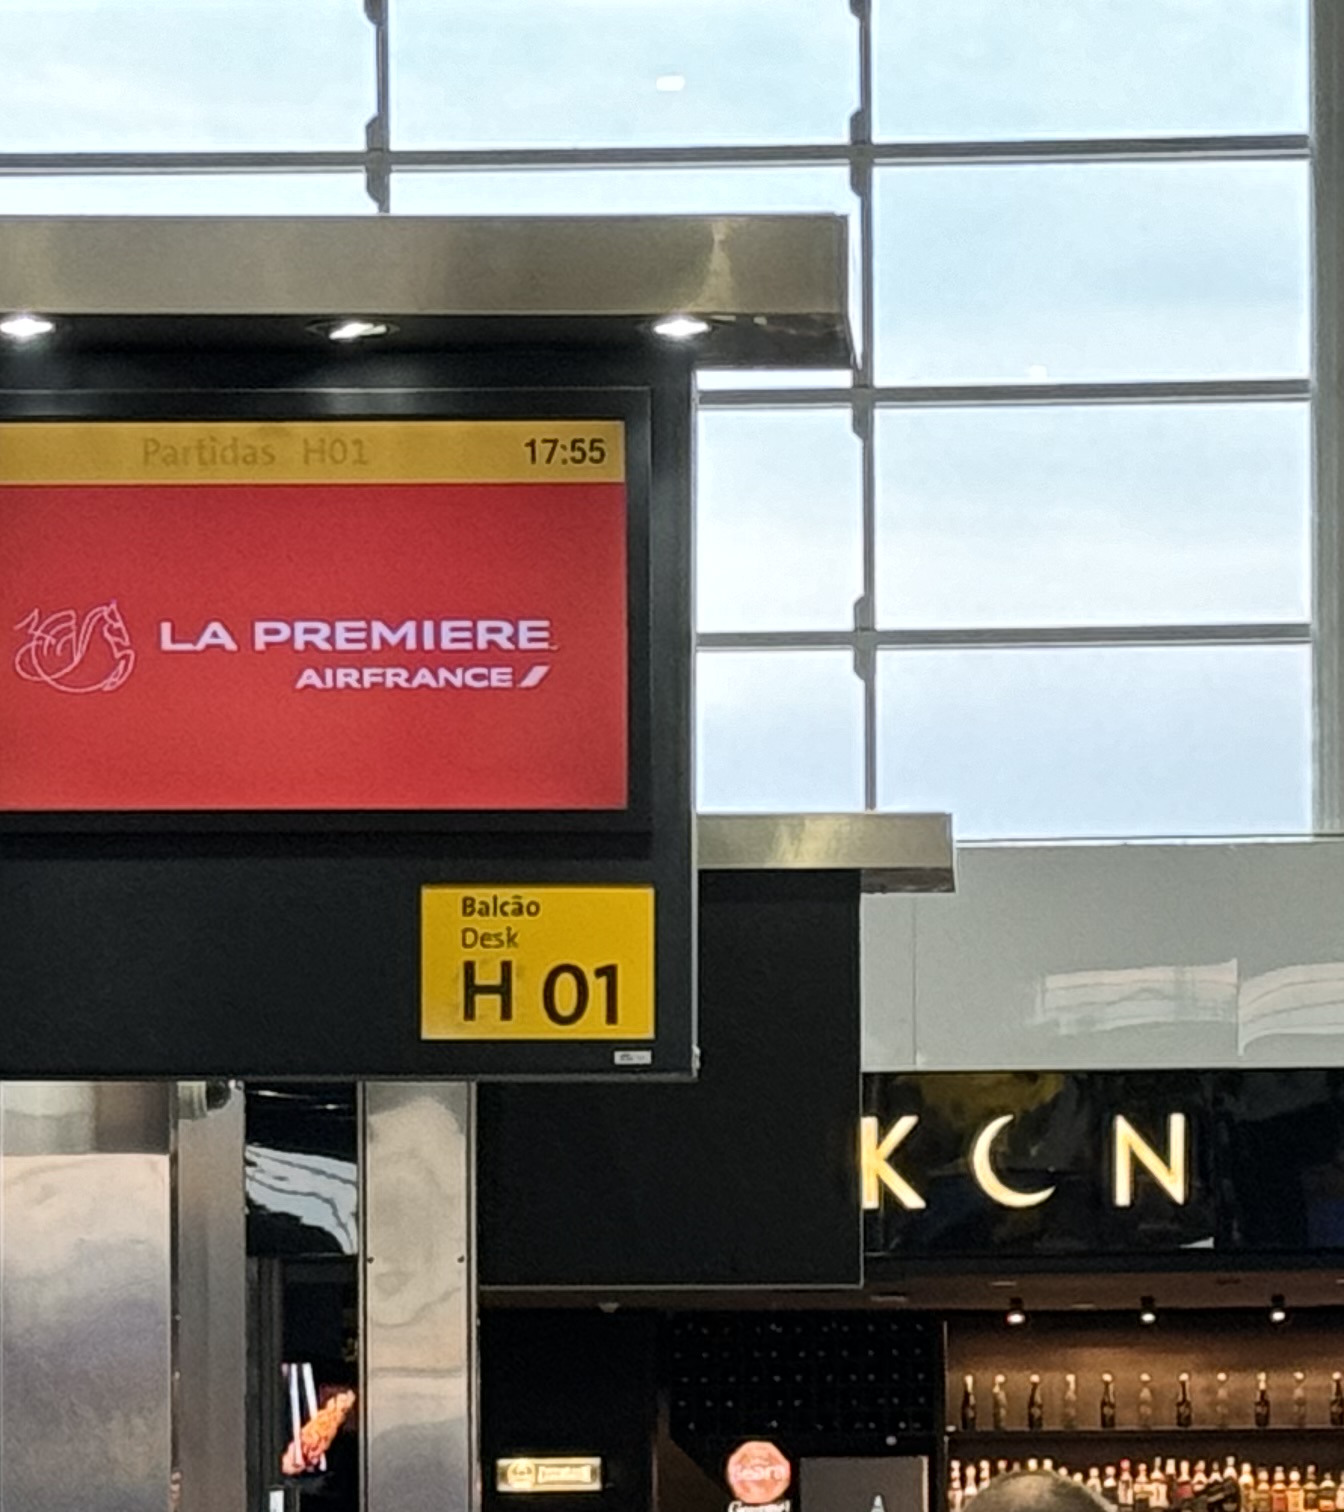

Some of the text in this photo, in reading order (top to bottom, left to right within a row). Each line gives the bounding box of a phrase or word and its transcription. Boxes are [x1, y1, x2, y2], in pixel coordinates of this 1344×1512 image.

[141, 434, 369, 467] Partidas H01
[523, 437, 608, 466] 17:55
[159, 619, 552, 652] LA PREMIERE
[293, 665, 514, 691] AIRFRANCE
[460, 893, 541, 920] Balcão
[460, 926, 520, 951] Desk
[462, 960, 621, 1027] H 01
